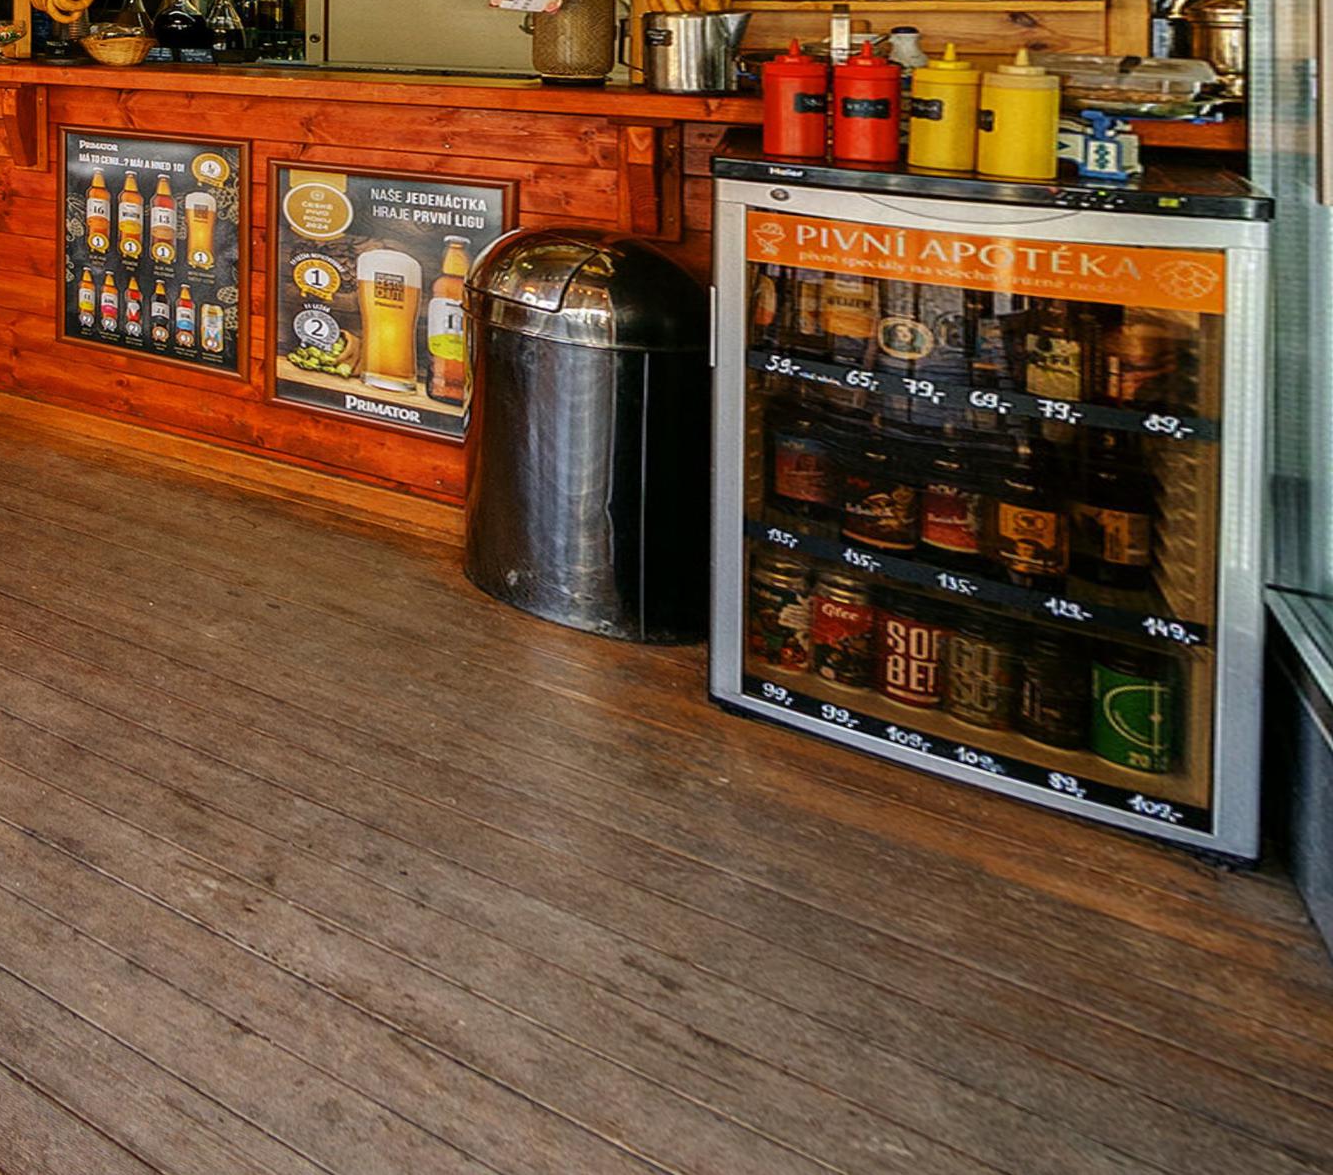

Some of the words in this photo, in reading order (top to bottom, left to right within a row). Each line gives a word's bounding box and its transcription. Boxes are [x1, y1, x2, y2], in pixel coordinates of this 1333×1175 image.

[79, 152, 90, 162] MÁ
[91, 154, 99, 163] TO
[144, 160, 150, 169] A
[151, 160, 171, 171] HNED
[93, 204, 105, 215] 16
[371, 188, 402, 202] NAŠE
[405, 190, 488, 213] JEDENÁCTKA
[158, 215, 170, 225] 13
[373, 205, 412, 221] HRAJE
[413, 208, 452, 226] PRVNÍ
[455, 214, 485, 230] LIGU
[94, 237, 101, 247] 1
[127, 242, 134, 252] 1
[160, 247, 166, 257] 1
[197, 252, 204, 262] 1
[796, 224, 906, 257] PIVNÍ
[919, 239, 1142, 281] APOTÉKA
[799, 251, 838, 264] pivní
[909, 264, 932, 274] na
[311, 269, 322, 287] 1
[311, 319, 323, 337] 2
[344, 395, 421, 423] PRIMATOR
